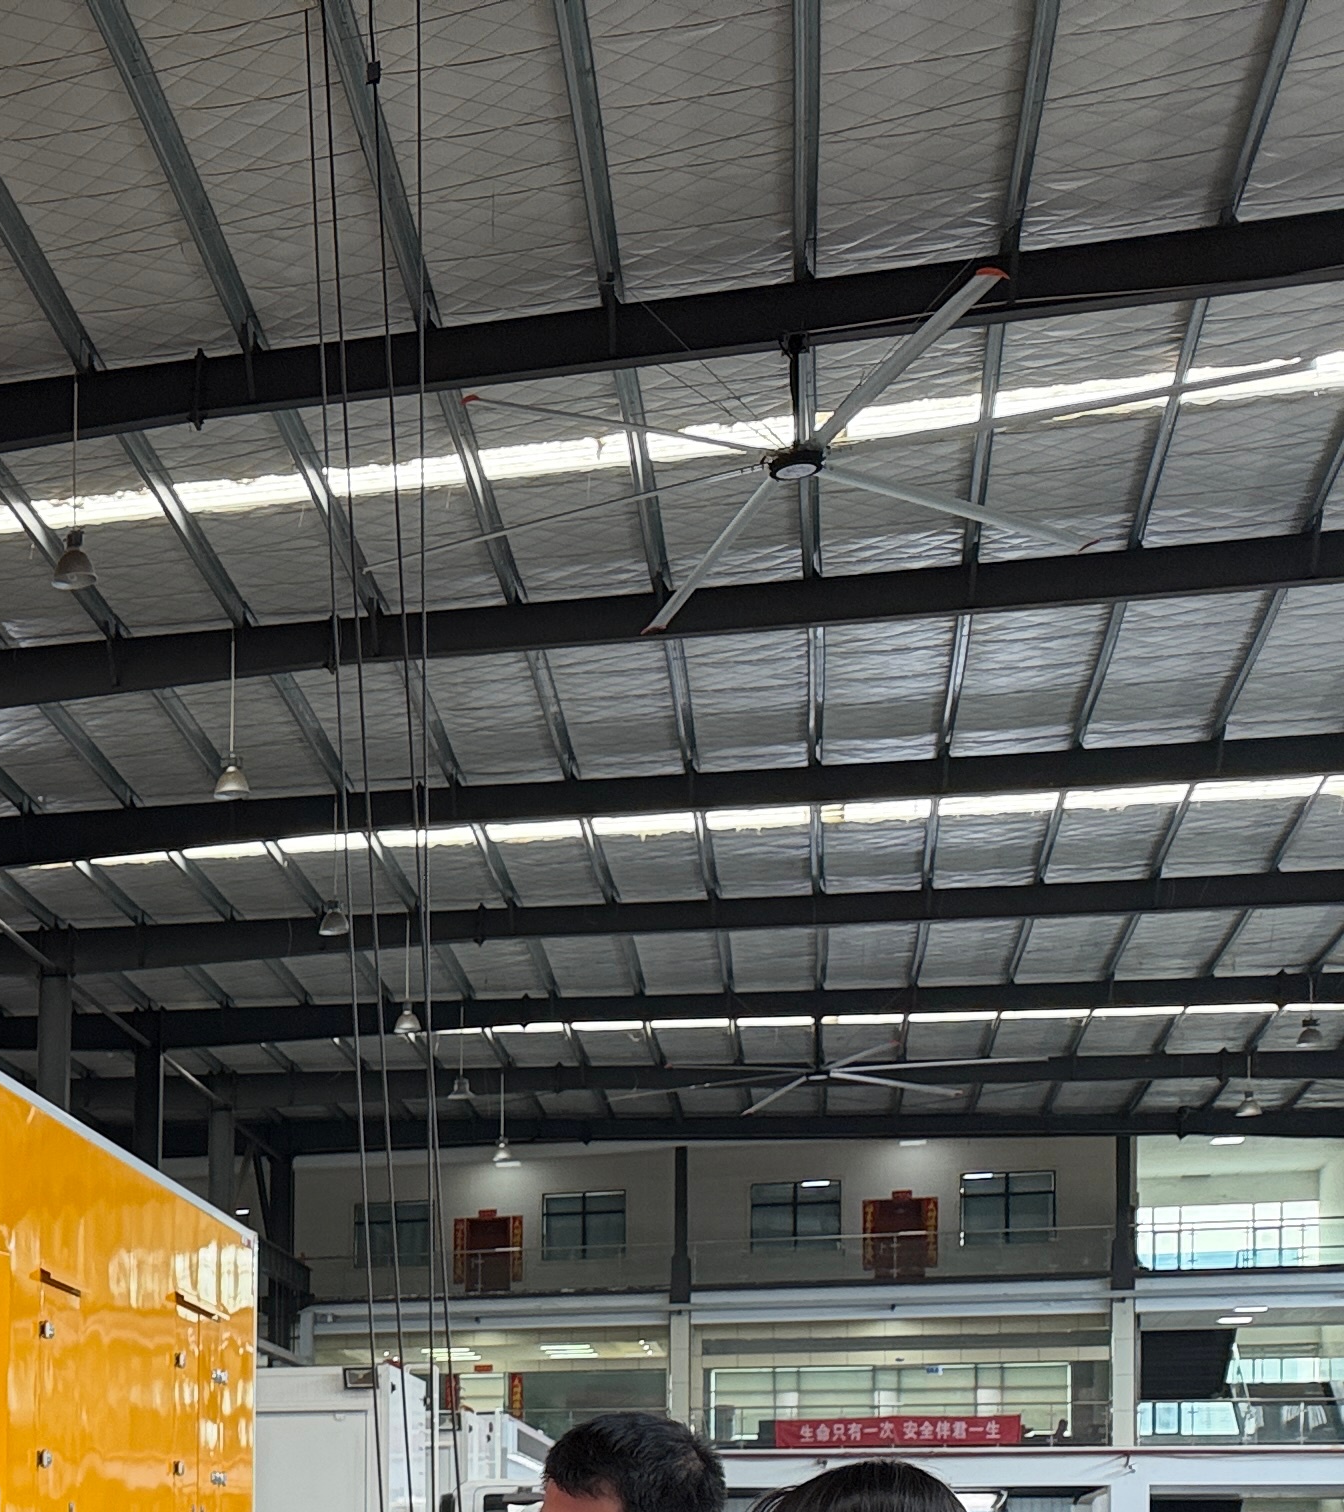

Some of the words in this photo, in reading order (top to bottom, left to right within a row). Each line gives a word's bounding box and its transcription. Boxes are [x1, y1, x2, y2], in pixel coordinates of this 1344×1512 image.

[800, 1422, 895, 1442] 生命只有一次
[903, 1420, 1001, 1440] 安全伴君一生
